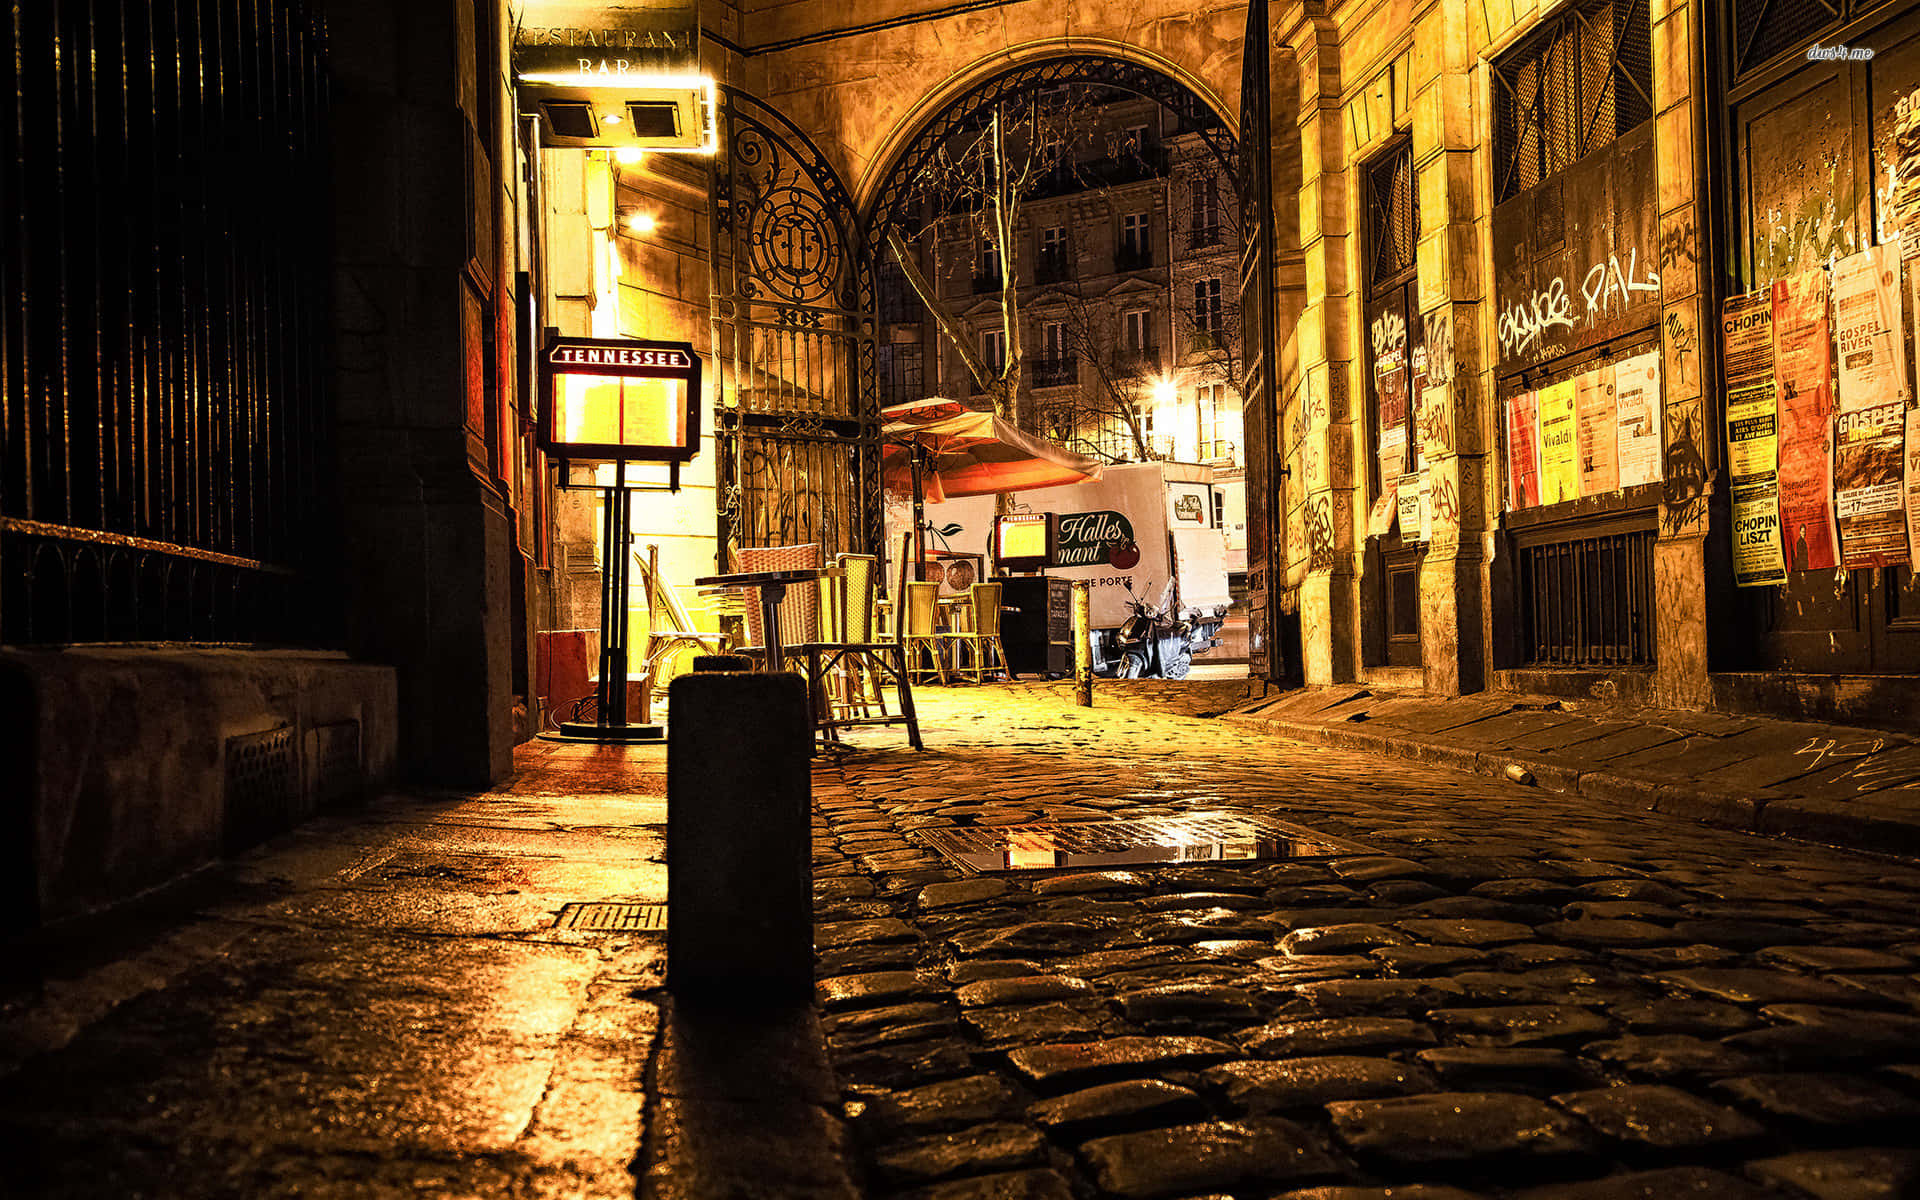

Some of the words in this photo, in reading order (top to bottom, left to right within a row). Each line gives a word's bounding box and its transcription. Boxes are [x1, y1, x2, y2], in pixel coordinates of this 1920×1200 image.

[578, 58, 630, 75] BAR
[1724, 309, 1771, 333] CHOPIN
[1840, 321, 1880, 341] GOSPEL
[1841, 335, 1872, 353] RIVER
[561, 349, 680, 365] TENNESSEE
[1543, 429, 1572, 448] Vivaldi
[1851, 501, 1861, 512] 17
[1058, 513, 1122, 544] Halles
[1734, 514, 1776, 532] CHOPIN
[1740, 529, 1771, 545] LISZT
[1099, 576, 1133, 587] PORTE
